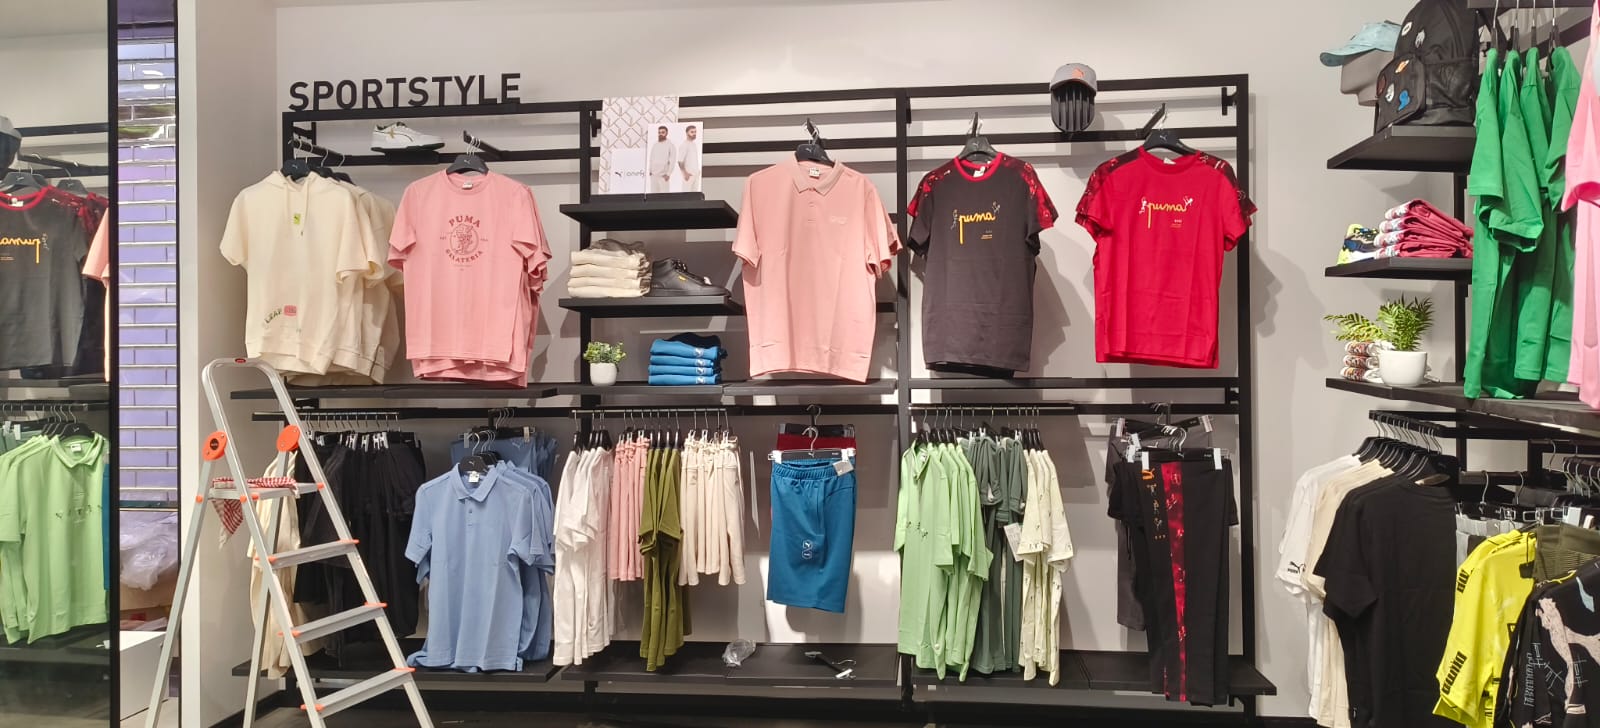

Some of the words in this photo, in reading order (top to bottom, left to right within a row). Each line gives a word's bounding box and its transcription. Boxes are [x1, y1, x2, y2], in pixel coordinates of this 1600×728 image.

[288, 73, 521, 111] SPORTSTYLE
[449, 215, 480, 228] PUMA
[958, 212, 996, 245] puma
[1147, 203, 1187, 229] puma
